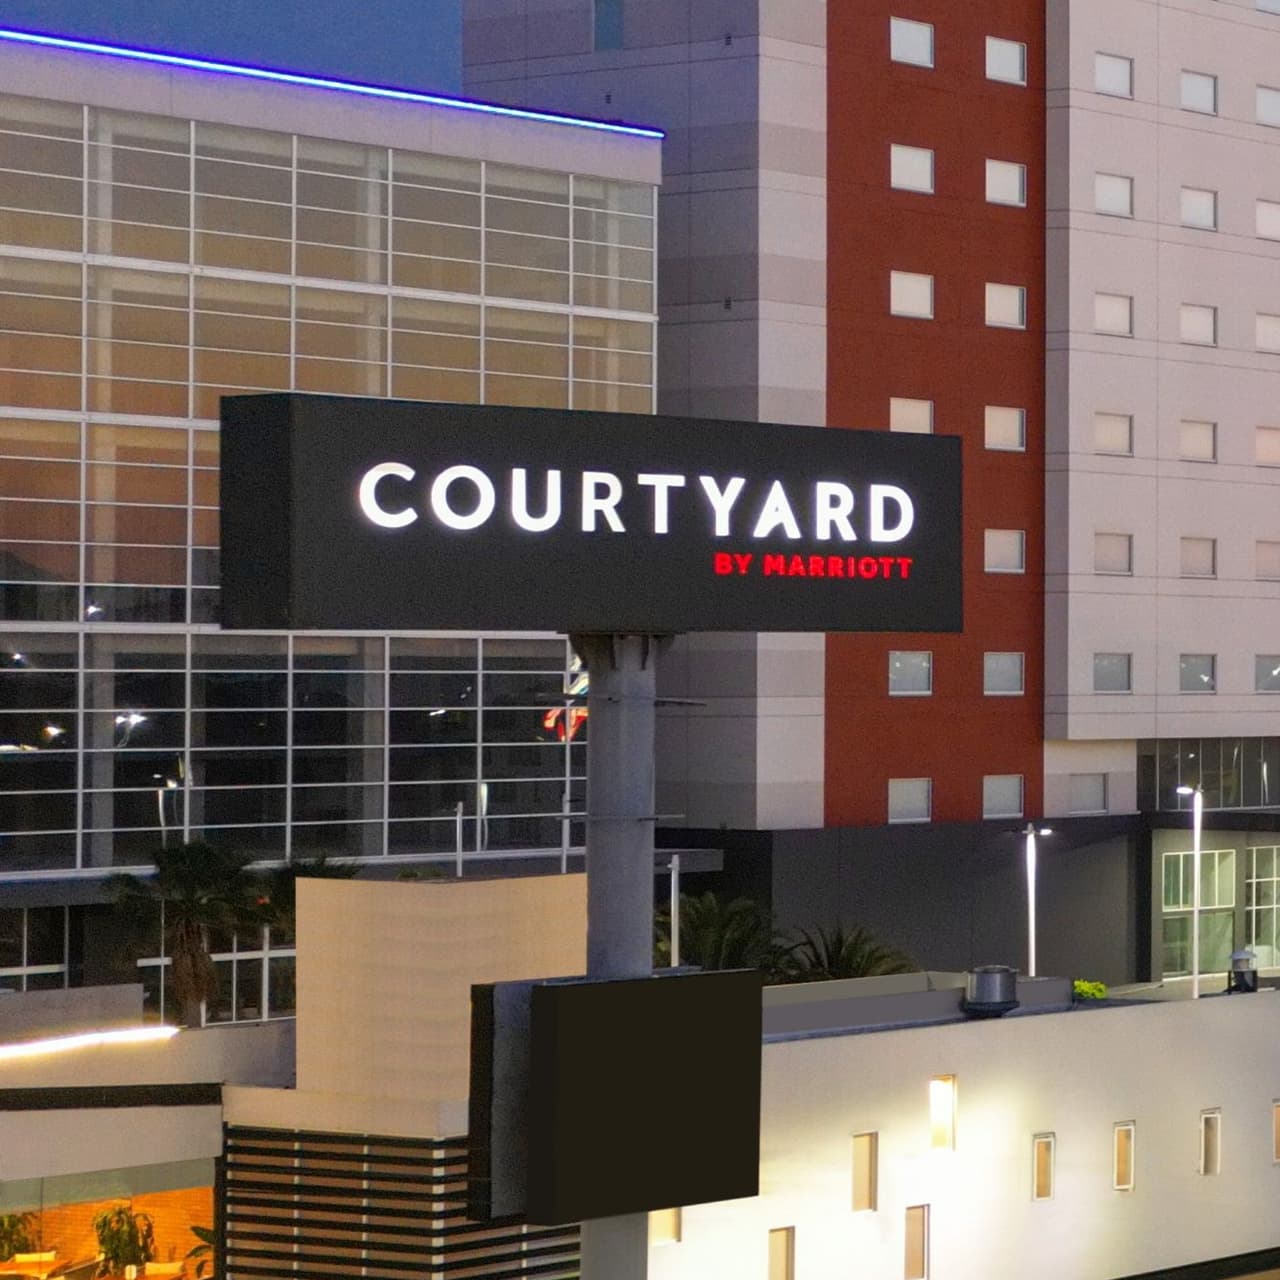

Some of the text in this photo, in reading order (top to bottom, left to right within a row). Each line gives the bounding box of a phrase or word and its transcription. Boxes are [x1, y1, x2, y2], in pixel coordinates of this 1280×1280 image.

[358, 462, 915, 542] COURTYARD
[714, 552, 913, 580] BY MARRIOTT
